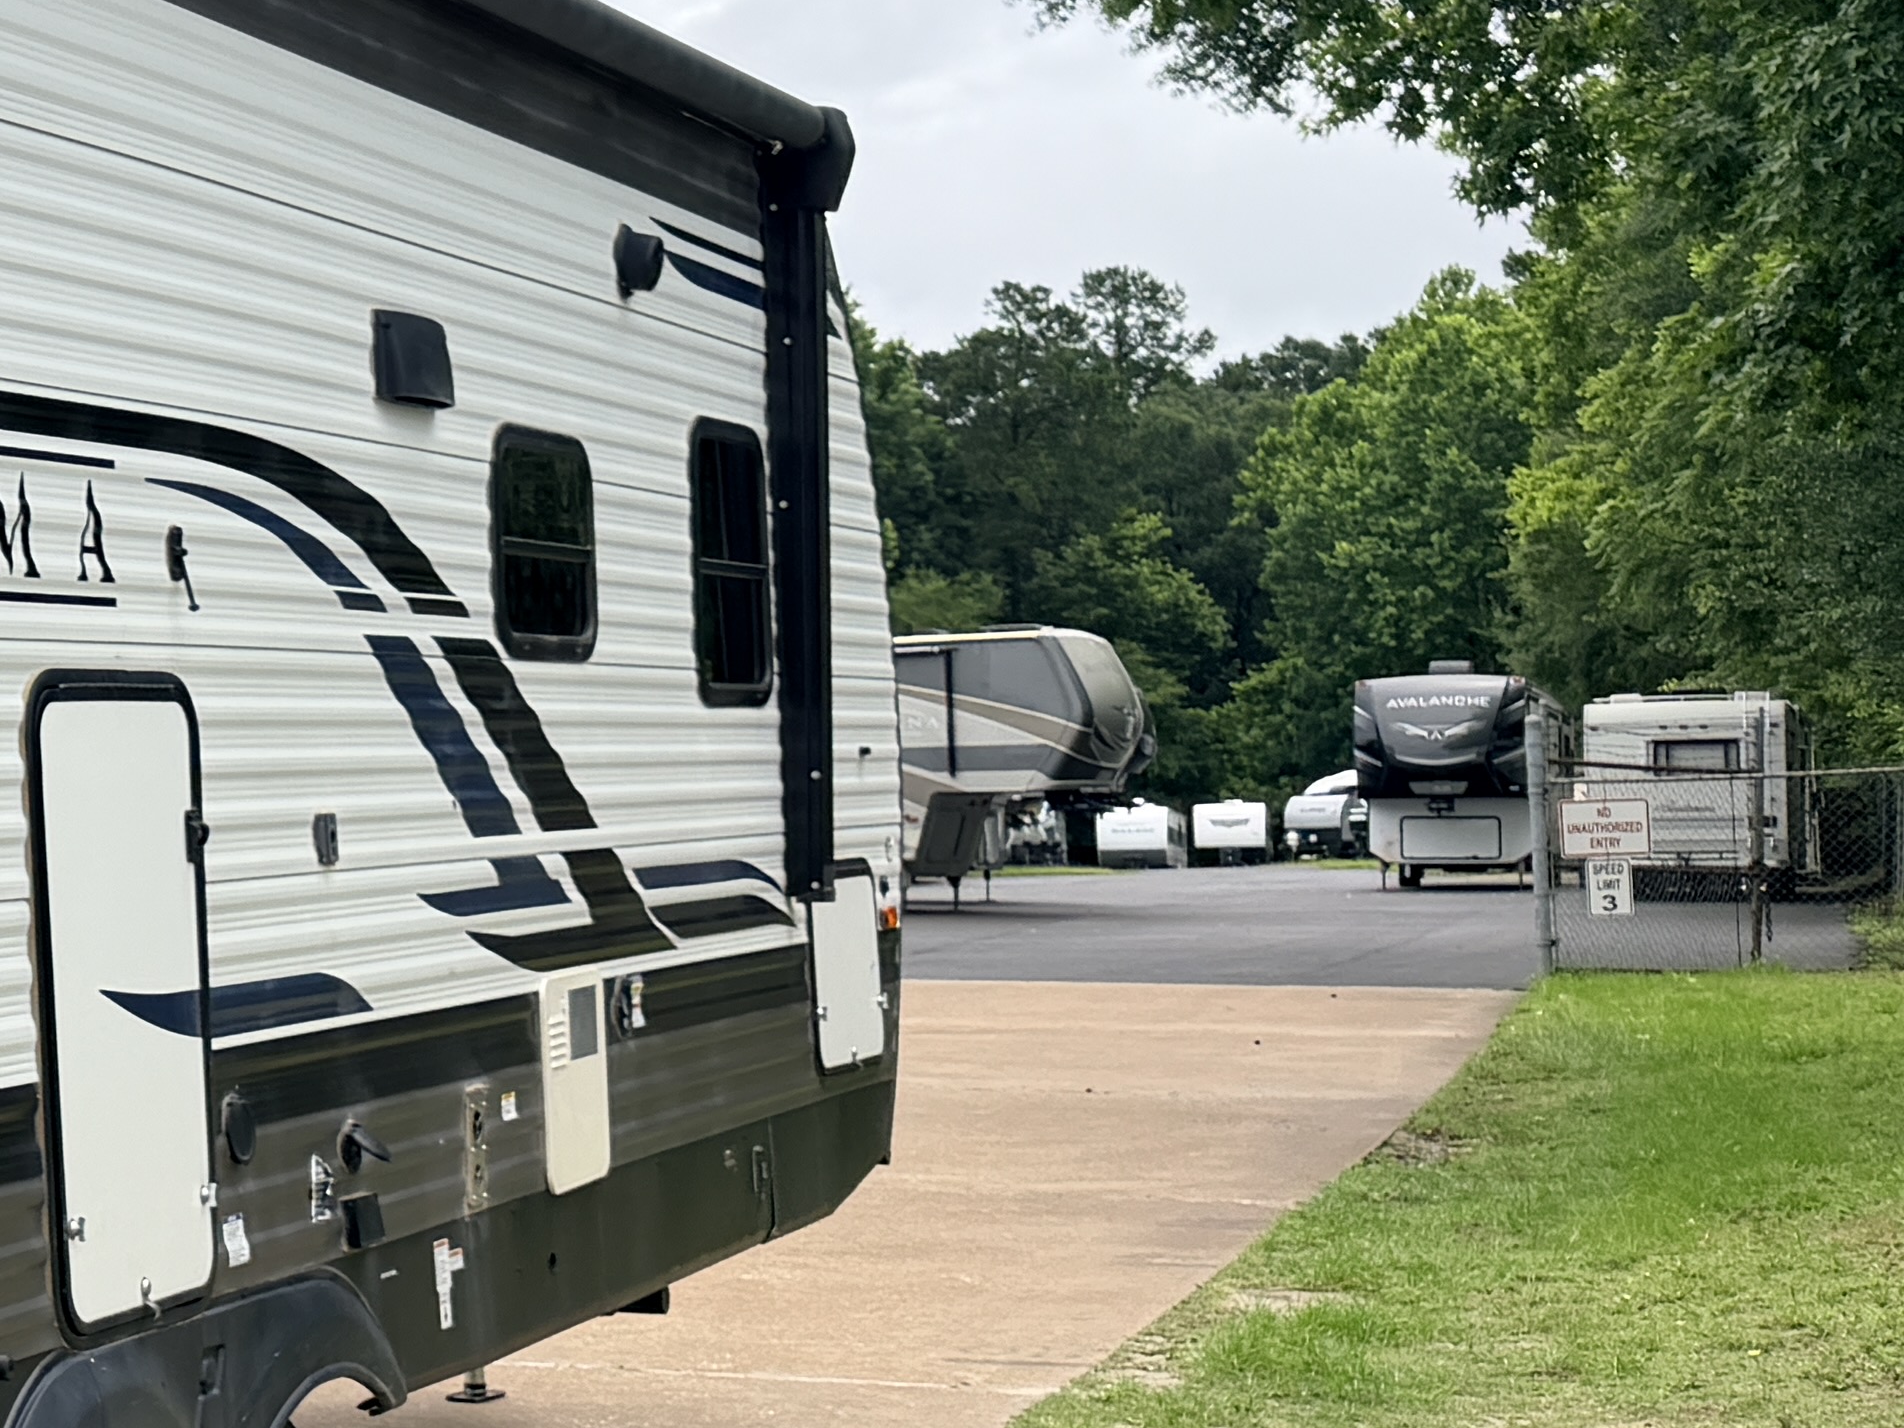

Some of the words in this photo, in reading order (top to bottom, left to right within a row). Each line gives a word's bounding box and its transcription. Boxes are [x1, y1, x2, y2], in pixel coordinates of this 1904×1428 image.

[1386, 694, 1492, 709] AVALANCHE
[1596, 806, 1612, 819] NO
[1566, 820, 1644, 835] UNAUTHORIZED
[1589, 836, 1622, 850] ENTRY
[1592, 862, 1625, 876] SPEED
[1596, 878, 1621, 891] LIMIT
[1601, 894, 1618, 912] 3
